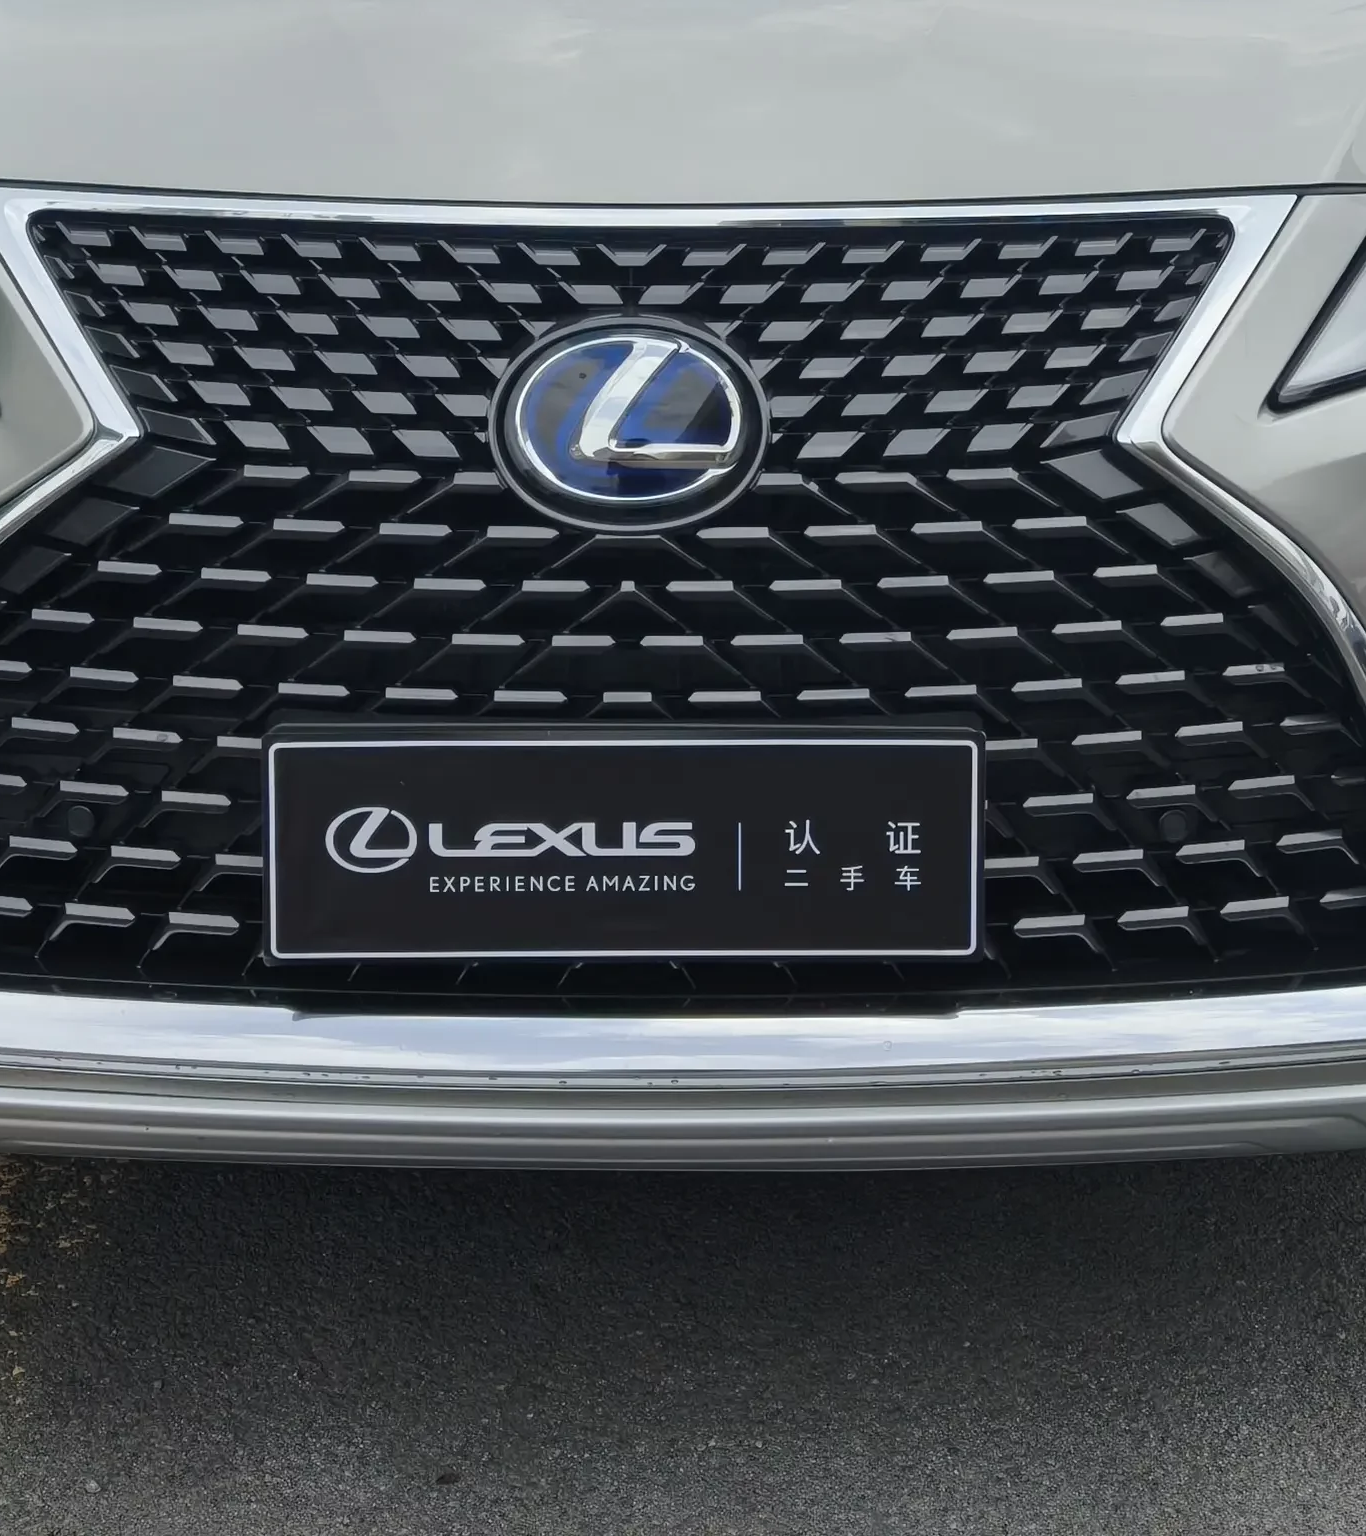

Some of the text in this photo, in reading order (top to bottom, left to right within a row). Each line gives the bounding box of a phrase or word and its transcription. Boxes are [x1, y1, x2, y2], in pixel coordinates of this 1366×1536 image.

[428, 820, 697, 858] LEXUS
[784, 819, 923, 856] 认证
[429, 874, 697, 893] EXPERIENCE AMAZING
[784, 864, 923, 892] 二手车
